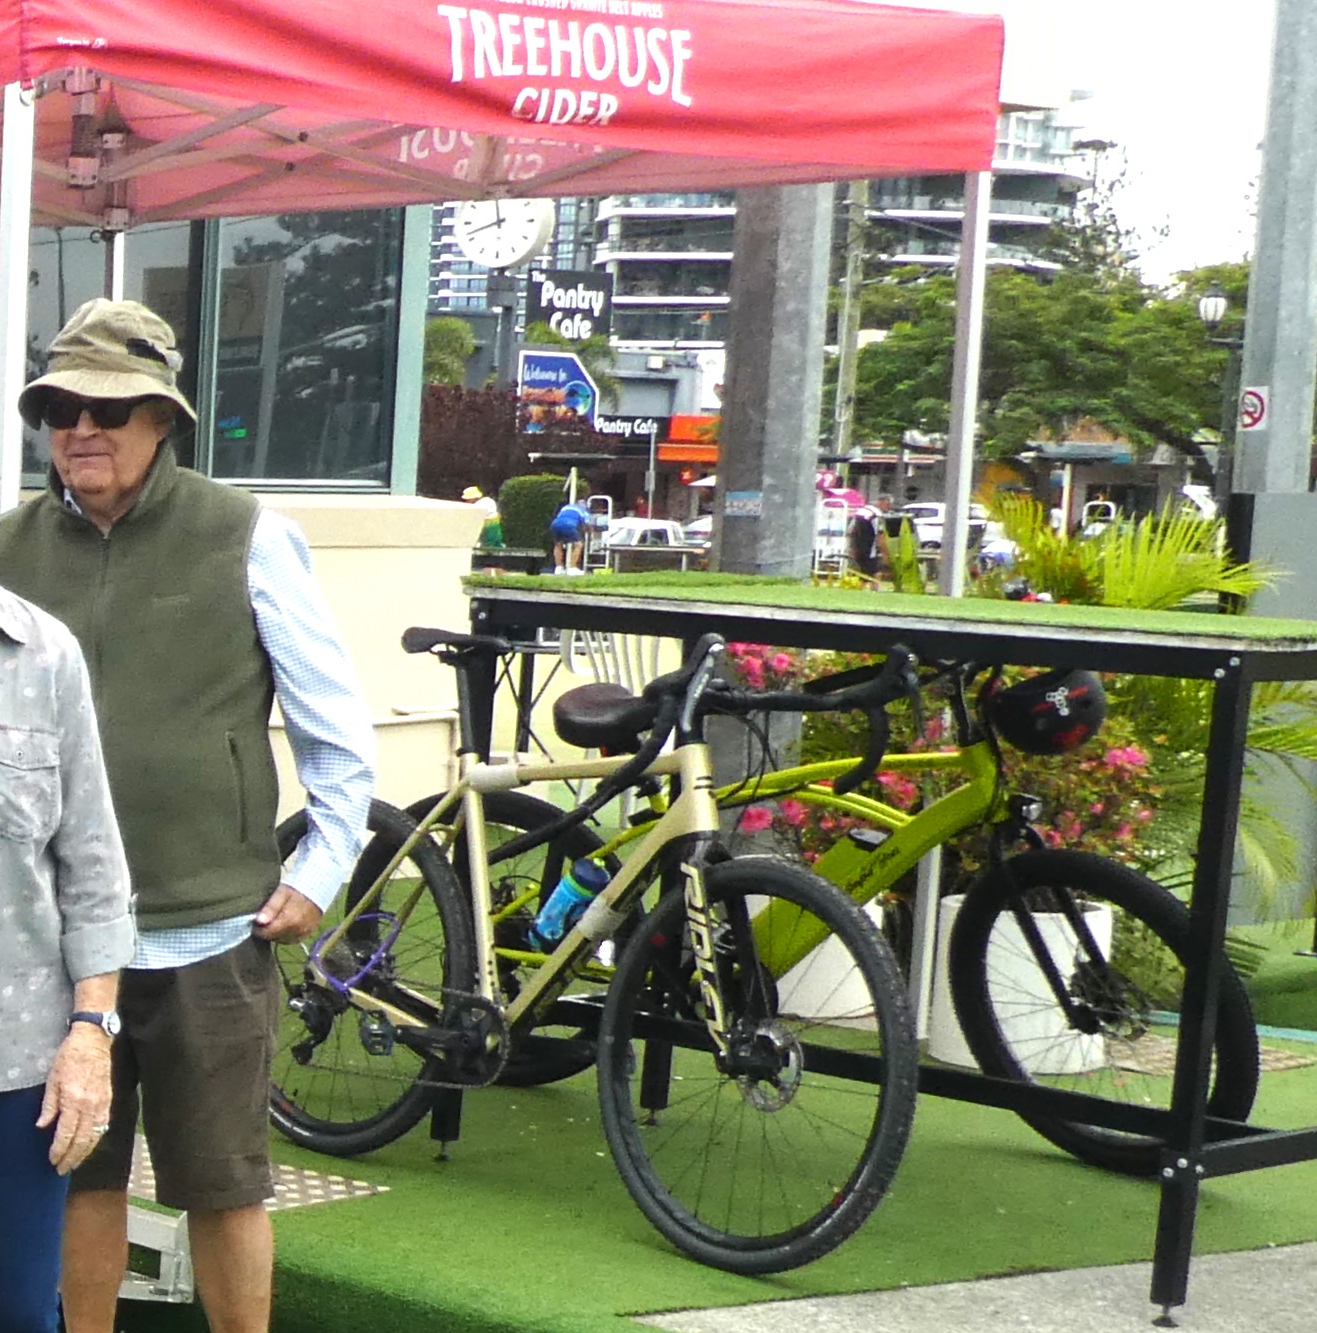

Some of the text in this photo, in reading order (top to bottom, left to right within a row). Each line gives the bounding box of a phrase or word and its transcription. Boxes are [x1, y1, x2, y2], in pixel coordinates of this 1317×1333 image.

[437, 4, 694, 108] TREEHOUSE
[511, 86, 619, 126] CIDER
[531, 270, 546, 283] The
[540, 280, 605, 317] Pantry
[549, 311, 592, 339] Cafe
[595, 417, 658, 438] Pantry Cafe
